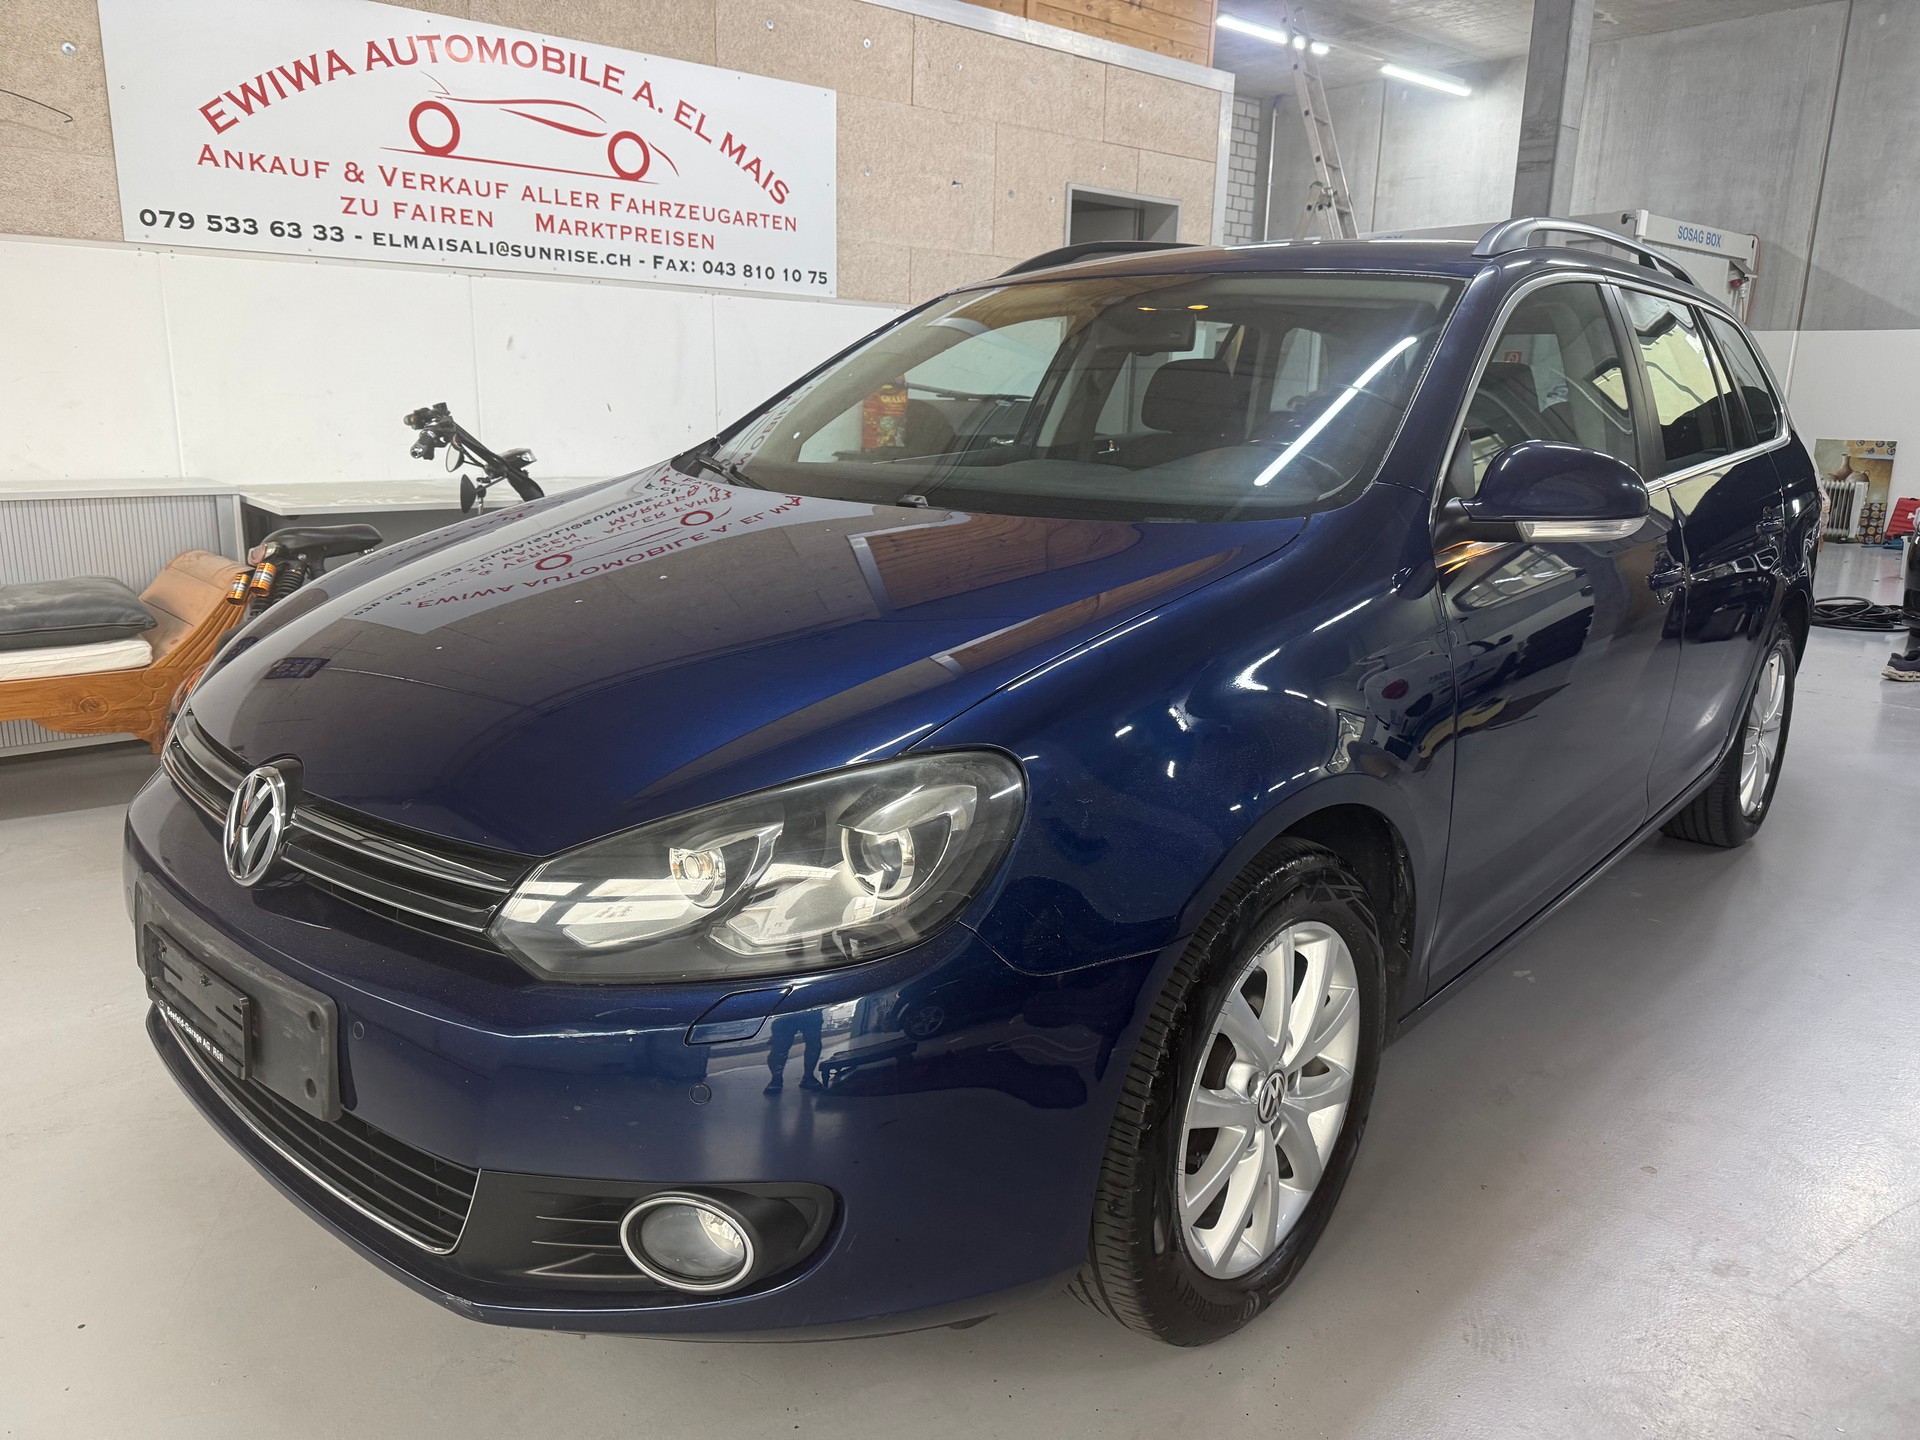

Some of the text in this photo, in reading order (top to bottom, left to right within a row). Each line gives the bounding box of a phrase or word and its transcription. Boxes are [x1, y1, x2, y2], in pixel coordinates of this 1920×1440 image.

[198, 33, 791, 206] EWIWA AUTOMOBILE A. EL MAIS
[196, 143, 797, 232] ANKAUF & VERKAUF ALLER FAHRZEUGARTEN
[339, 195, 716, 251] ZU FAIREN MARKTPREISEN
[139, 208, 195, 230] 079
[206, 214, 259, 236] 533
[269, 220, 303, 239] 63
[312, 224, 345, 243] 33
[372, 232, 631, 267] ELMAISALI@SUNRISE.CH
[653, 255, 695, 273] FAX:
[702, 260, 736, 277] 043
[743, 264, 775, 280] 810
[783, 268, 802, 283] 10
[807, 270, 828, 285] 75
[1677, 225, 1722, 248] SOSAG BOX
